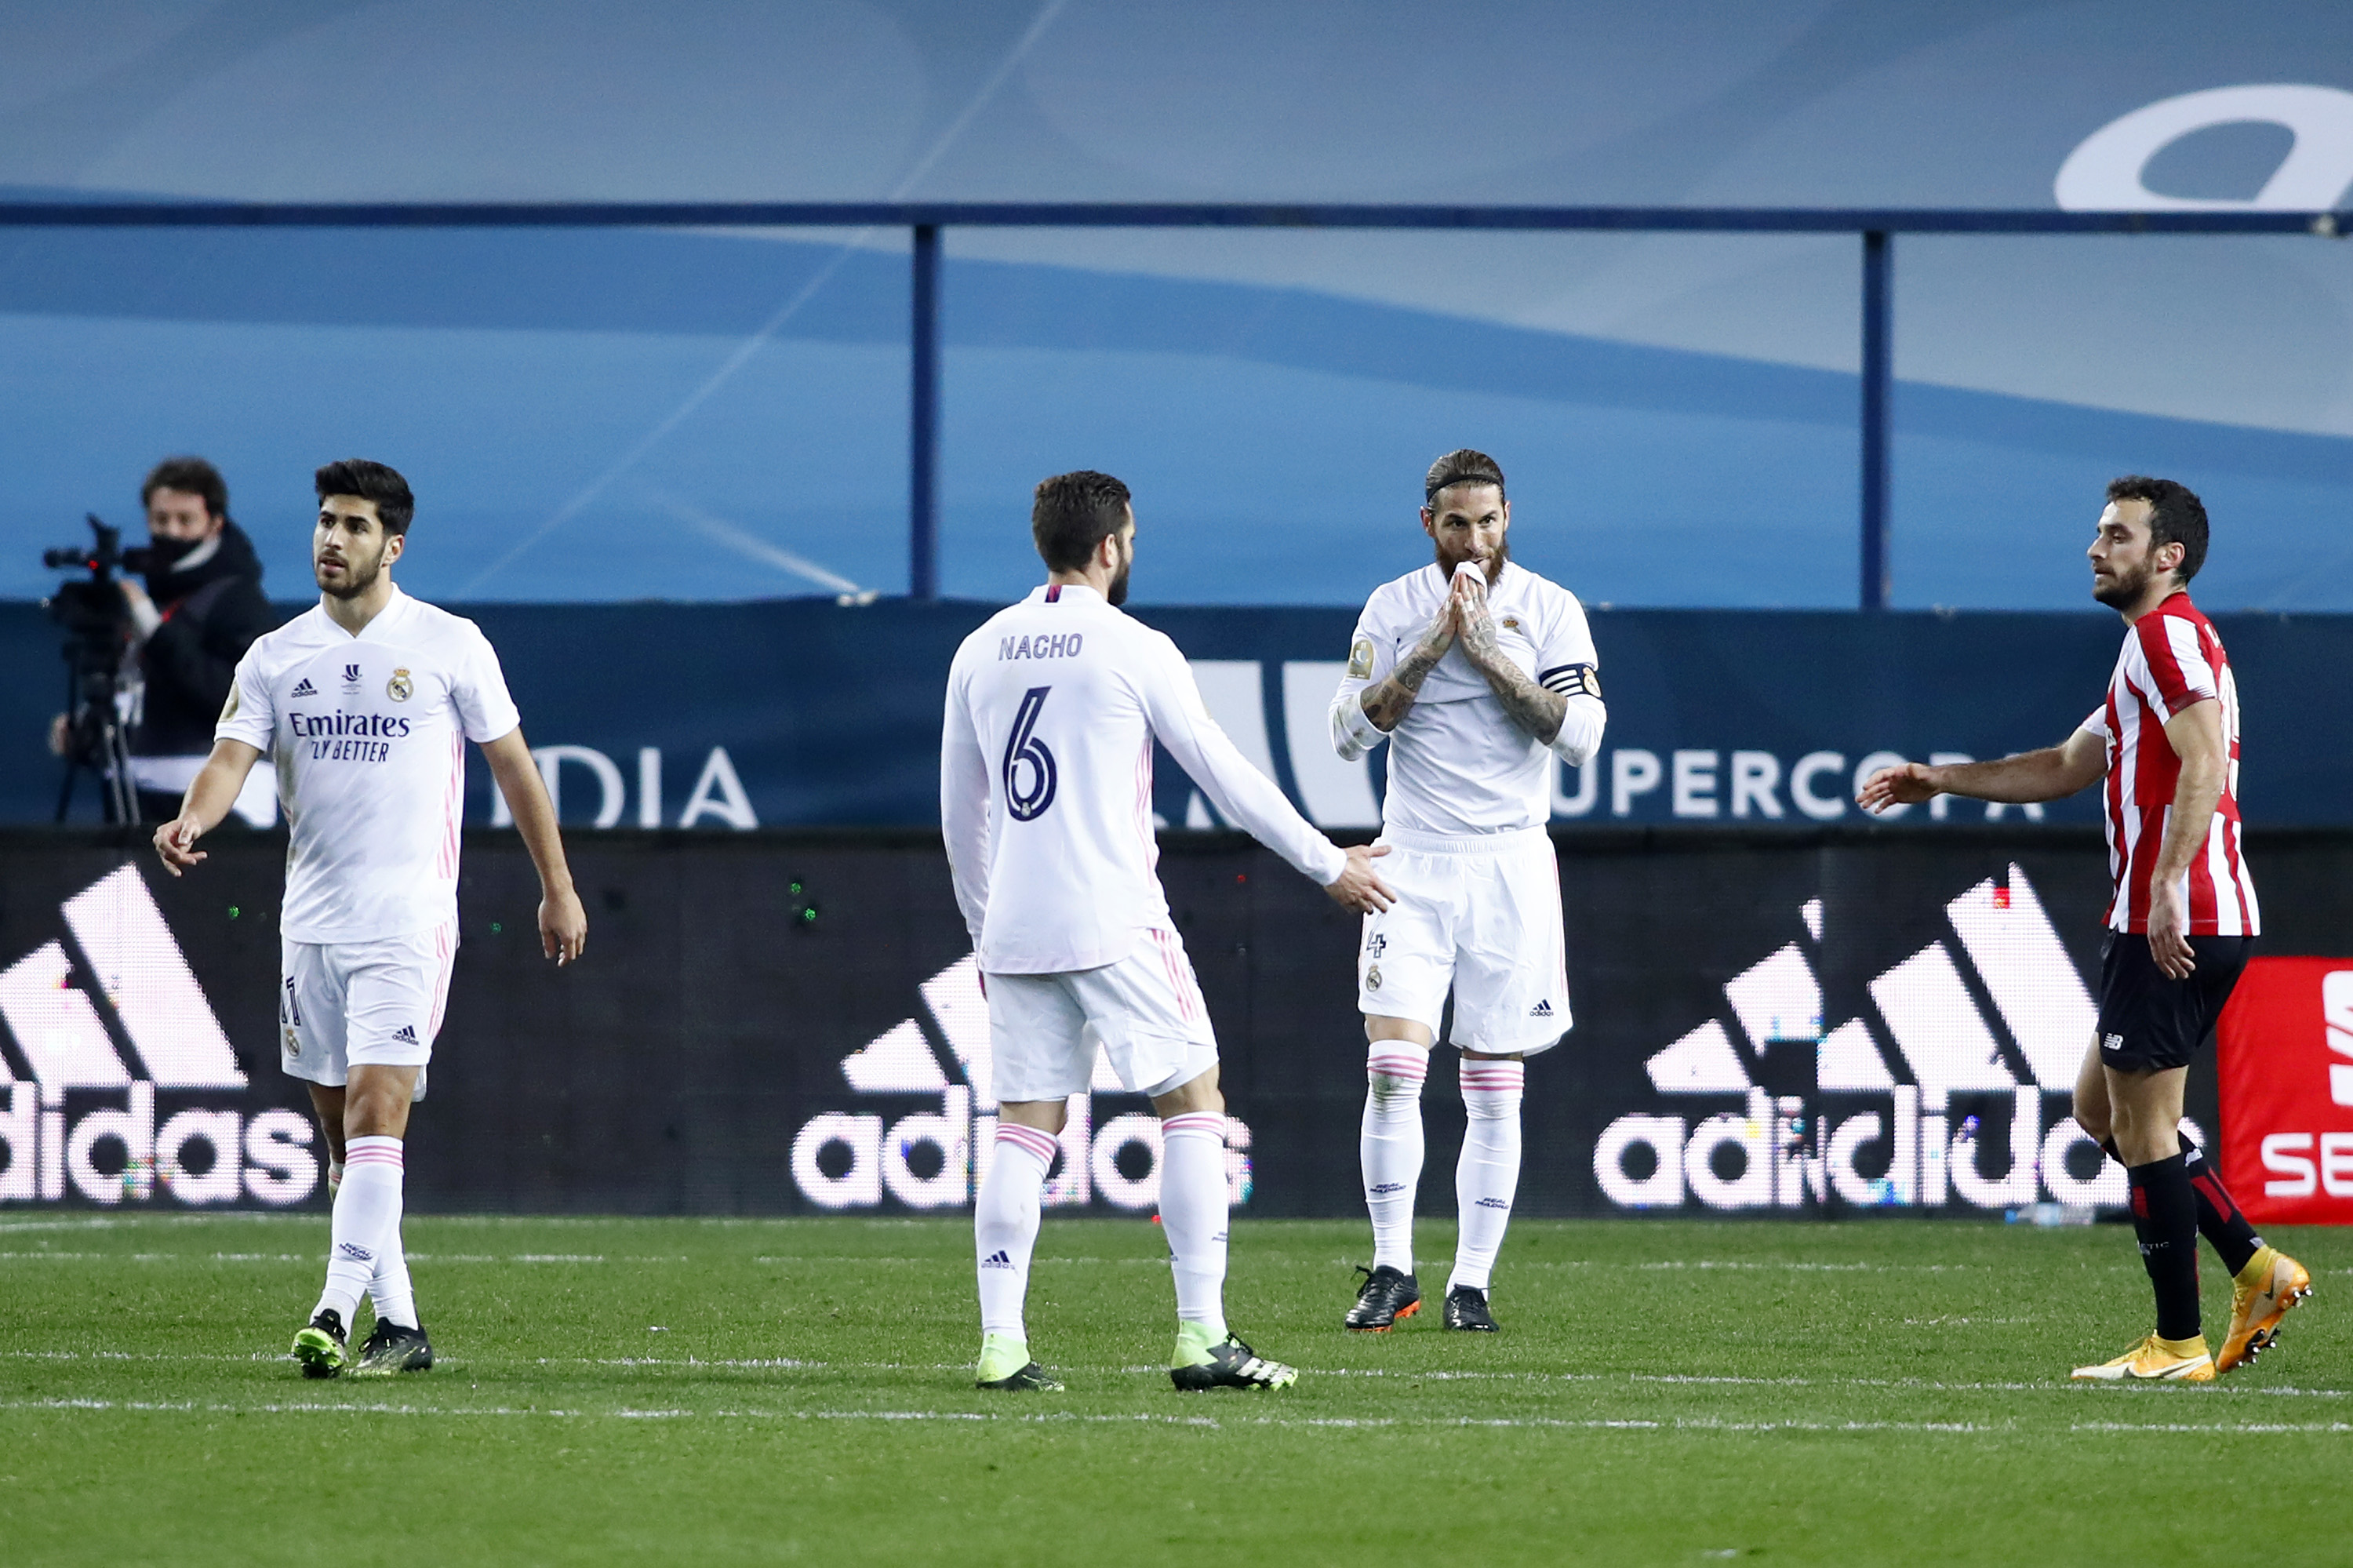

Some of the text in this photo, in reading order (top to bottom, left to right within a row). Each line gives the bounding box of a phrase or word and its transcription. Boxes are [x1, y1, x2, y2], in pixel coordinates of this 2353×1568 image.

[998, 633, 1082, 661] NACHO
[291, 689, 318, 698] adidas
[289, 708, 410, 737] Emirates
[332, 740, 389, 762] BETTER
[1002, 685, 1057, 822] 6
[1366, 927, 1387, 959] 4
[392, 1034, 419, 1046] adidas
